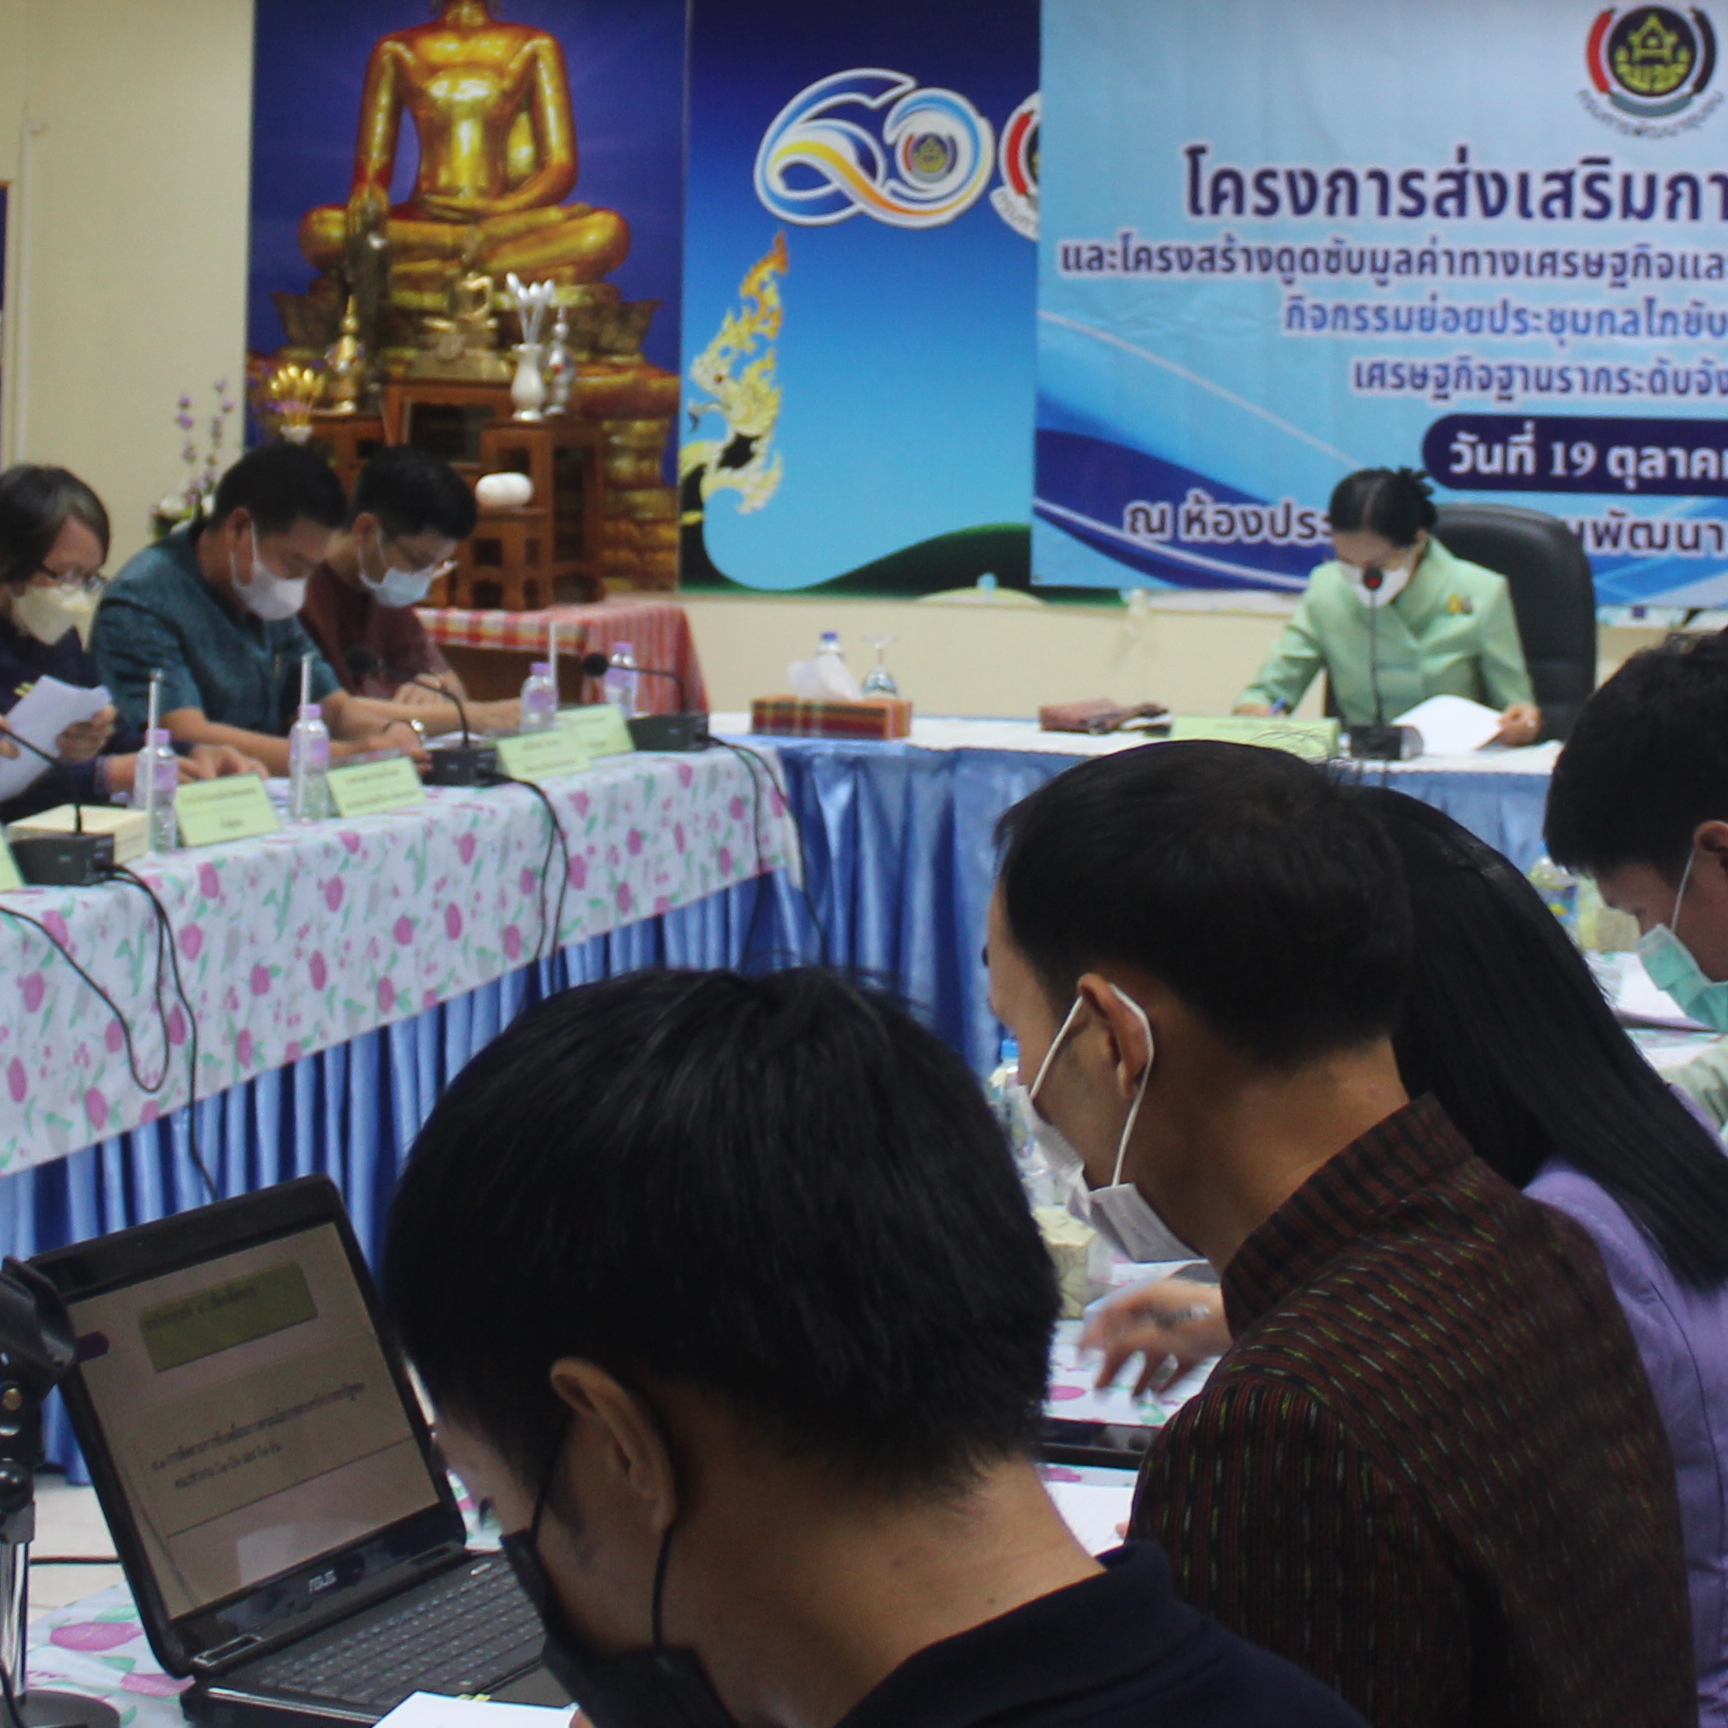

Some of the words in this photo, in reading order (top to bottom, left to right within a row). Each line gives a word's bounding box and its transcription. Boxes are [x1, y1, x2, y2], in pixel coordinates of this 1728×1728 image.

[1449, 421, 1536, 475] วันที่
[1549, 440, 1597, 474] 19
[1129, 505, 1166, 536] ณ
